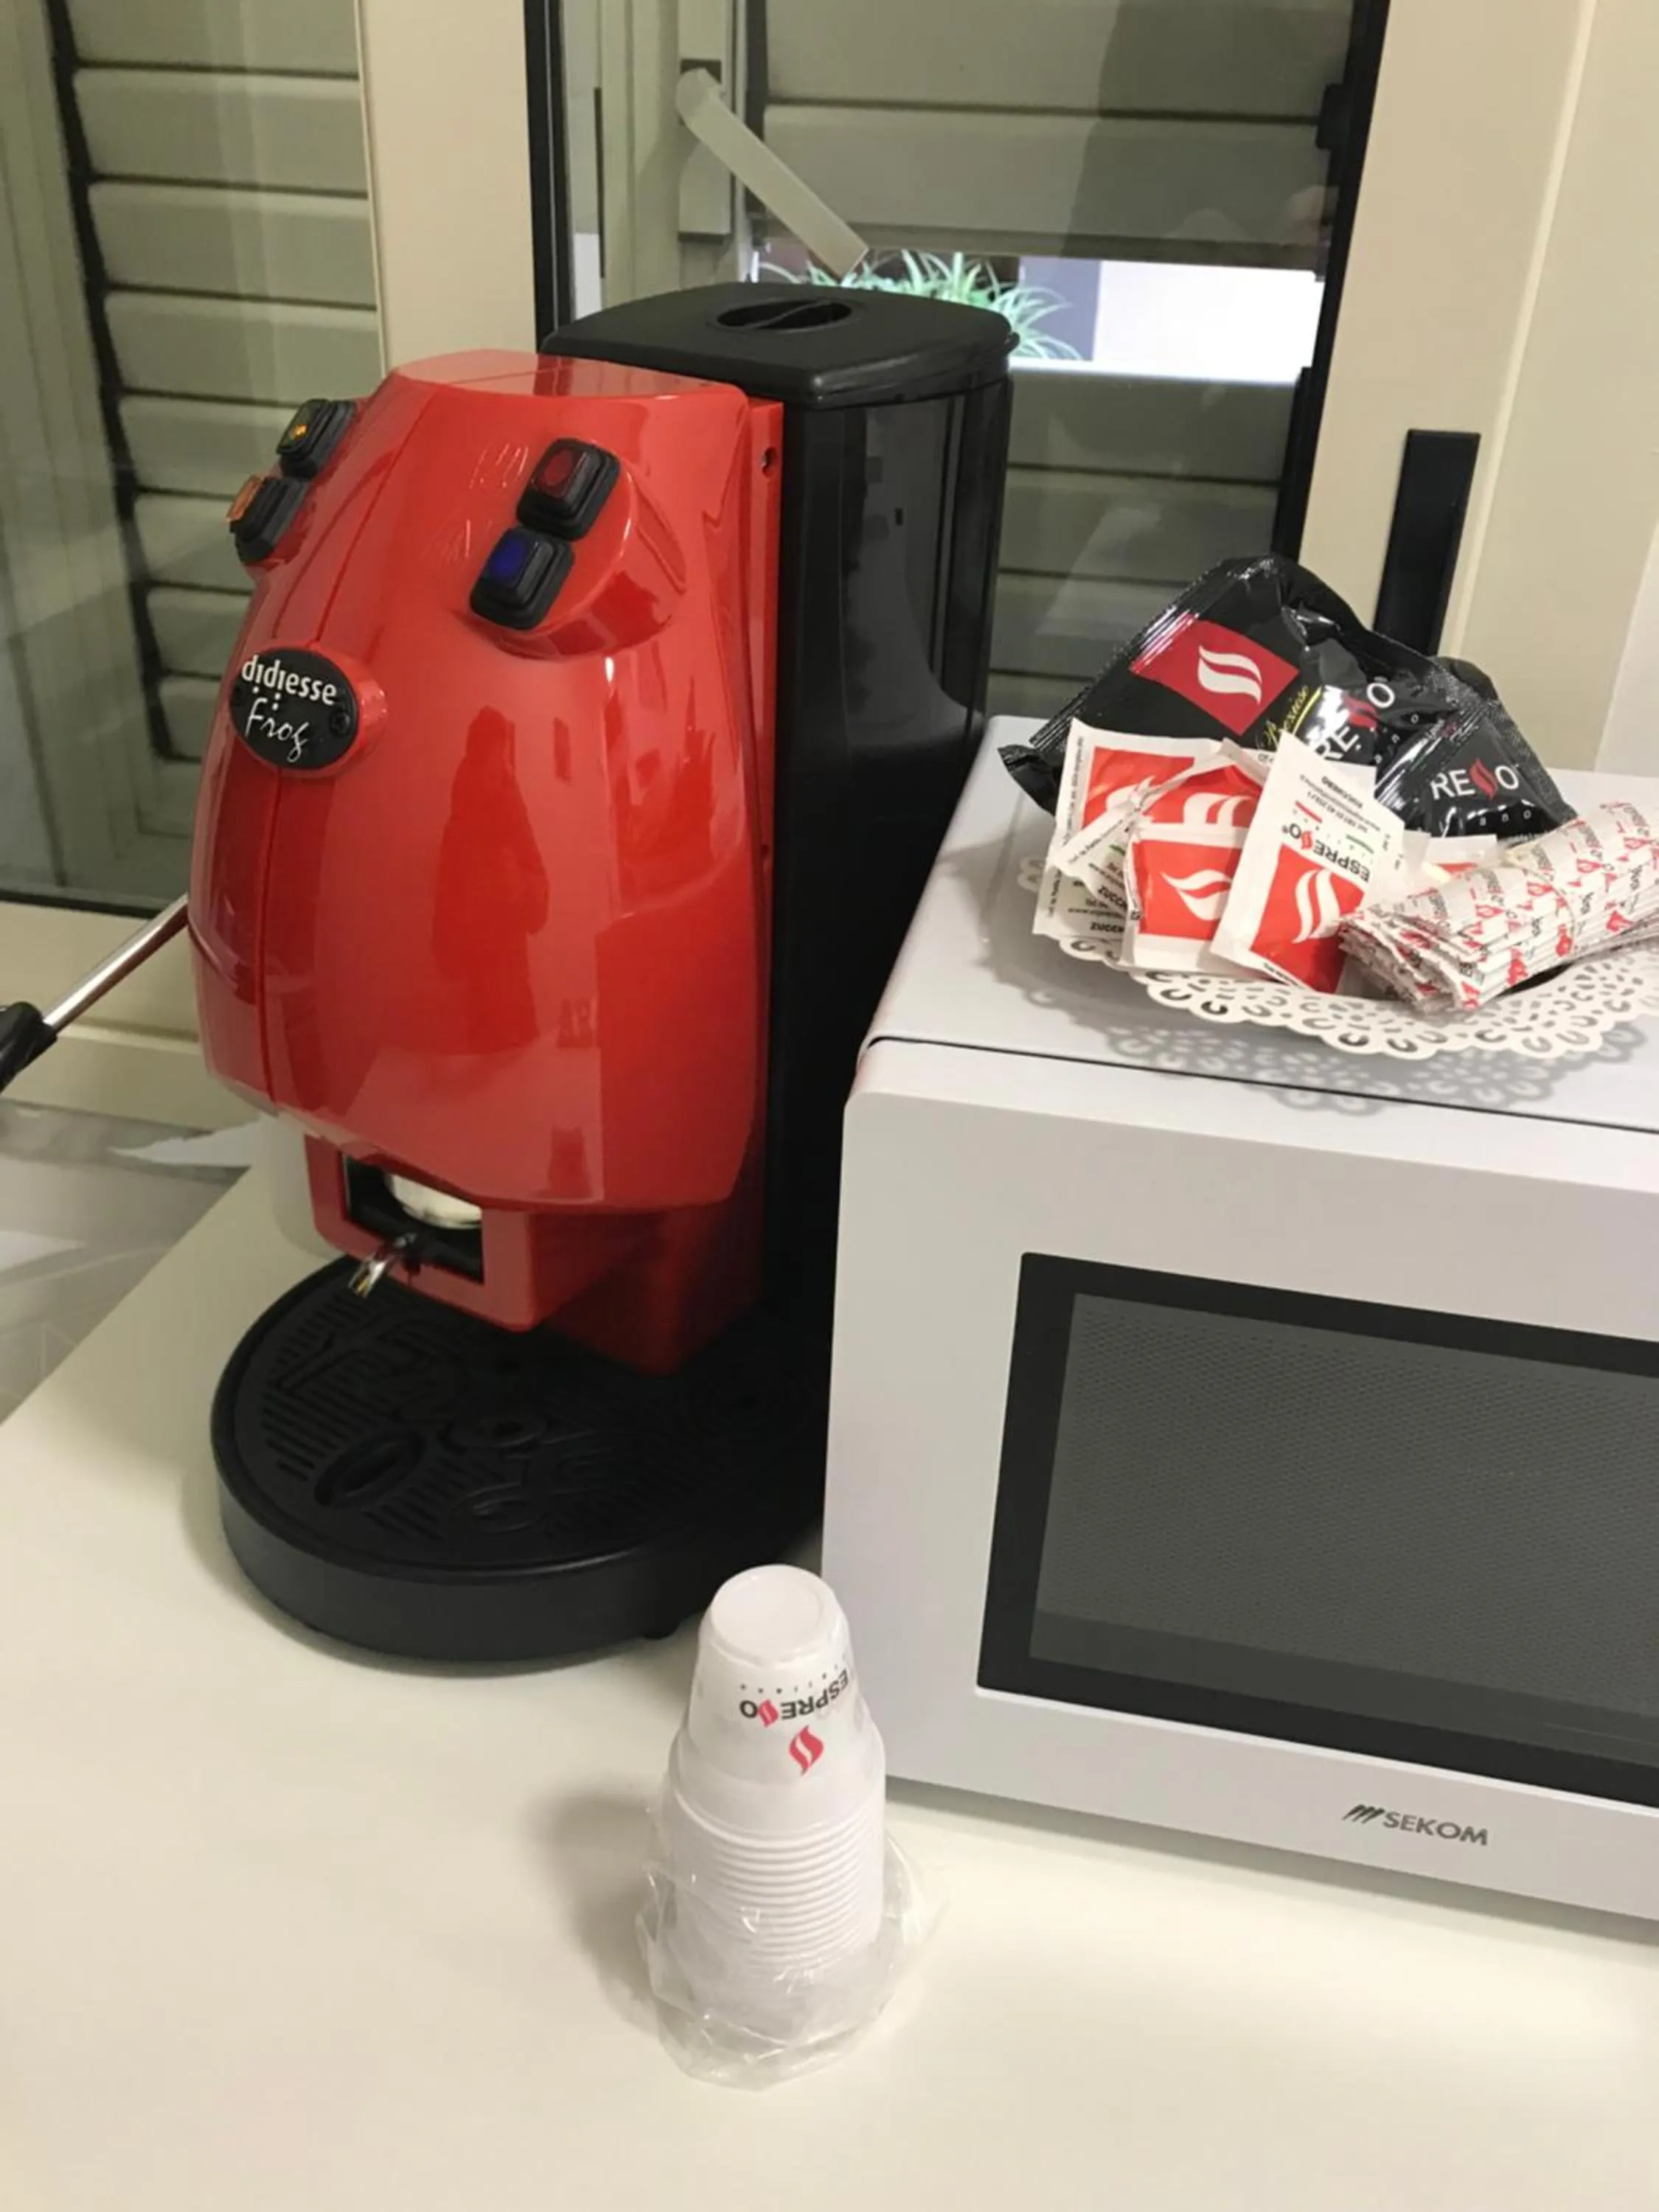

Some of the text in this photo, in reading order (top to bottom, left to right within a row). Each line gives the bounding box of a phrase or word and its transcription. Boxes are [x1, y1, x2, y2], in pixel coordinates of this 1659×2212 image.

[242, 655, 337, 706] didiesse
[246, 698, 310, 763] Frog
[1382, 1811, 1489, 1846] SEKOM
